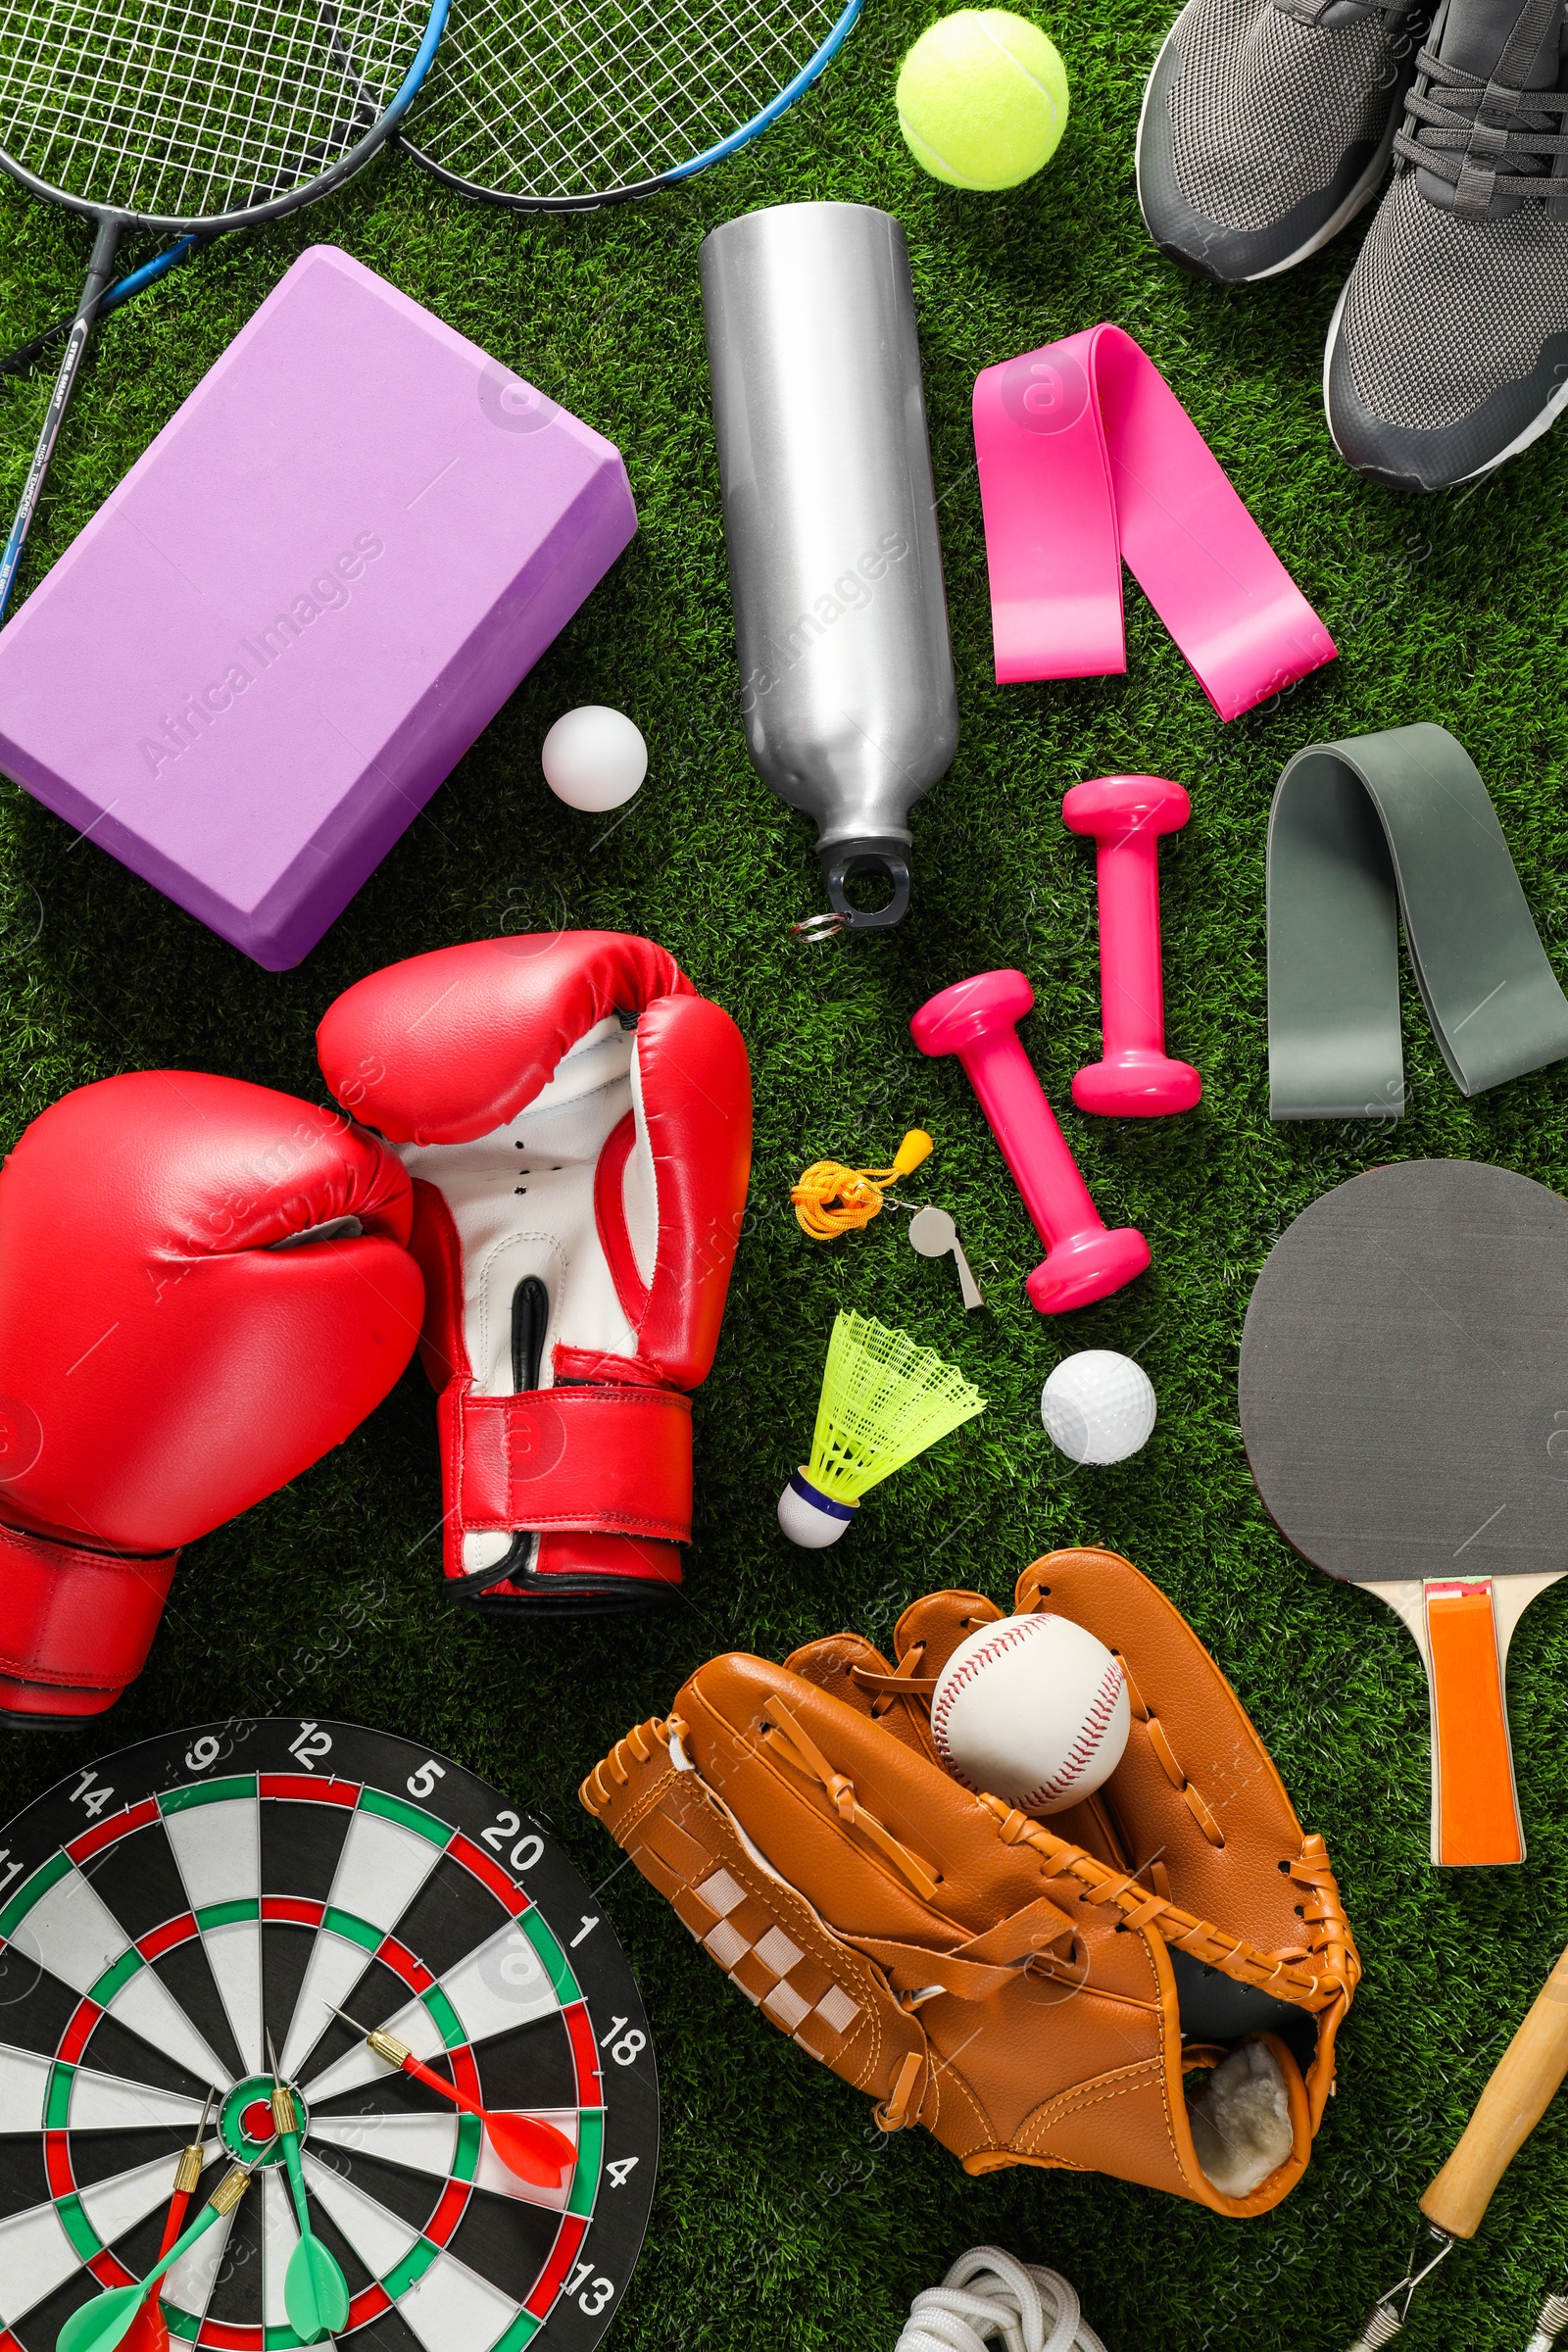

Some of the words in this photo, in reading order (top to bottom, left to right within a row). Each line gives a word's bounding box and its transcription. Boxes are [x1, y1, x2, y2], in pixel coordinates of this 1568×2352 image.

[64, 340, 78, 372] STEEL
[53, 373, 69, 409] SHAFT
[35, 444, 47, 466] HIGH
[21, 472, 39, 518] TEMPERED
[185, 1736, 220, 1771] 9
[288, 1721, 333, 1771] 12
[69, 1770, 115, 1818] 14
[407, 1759, 446, 1798] 5
[480, 1811, 545, 1871] 20
[569, 1915, 600, 1948] 1
[600, 2016, 647, 2066] 18
[606, 2156, 639, 2188] 4
[568, 2263, 614, 2317] 13
